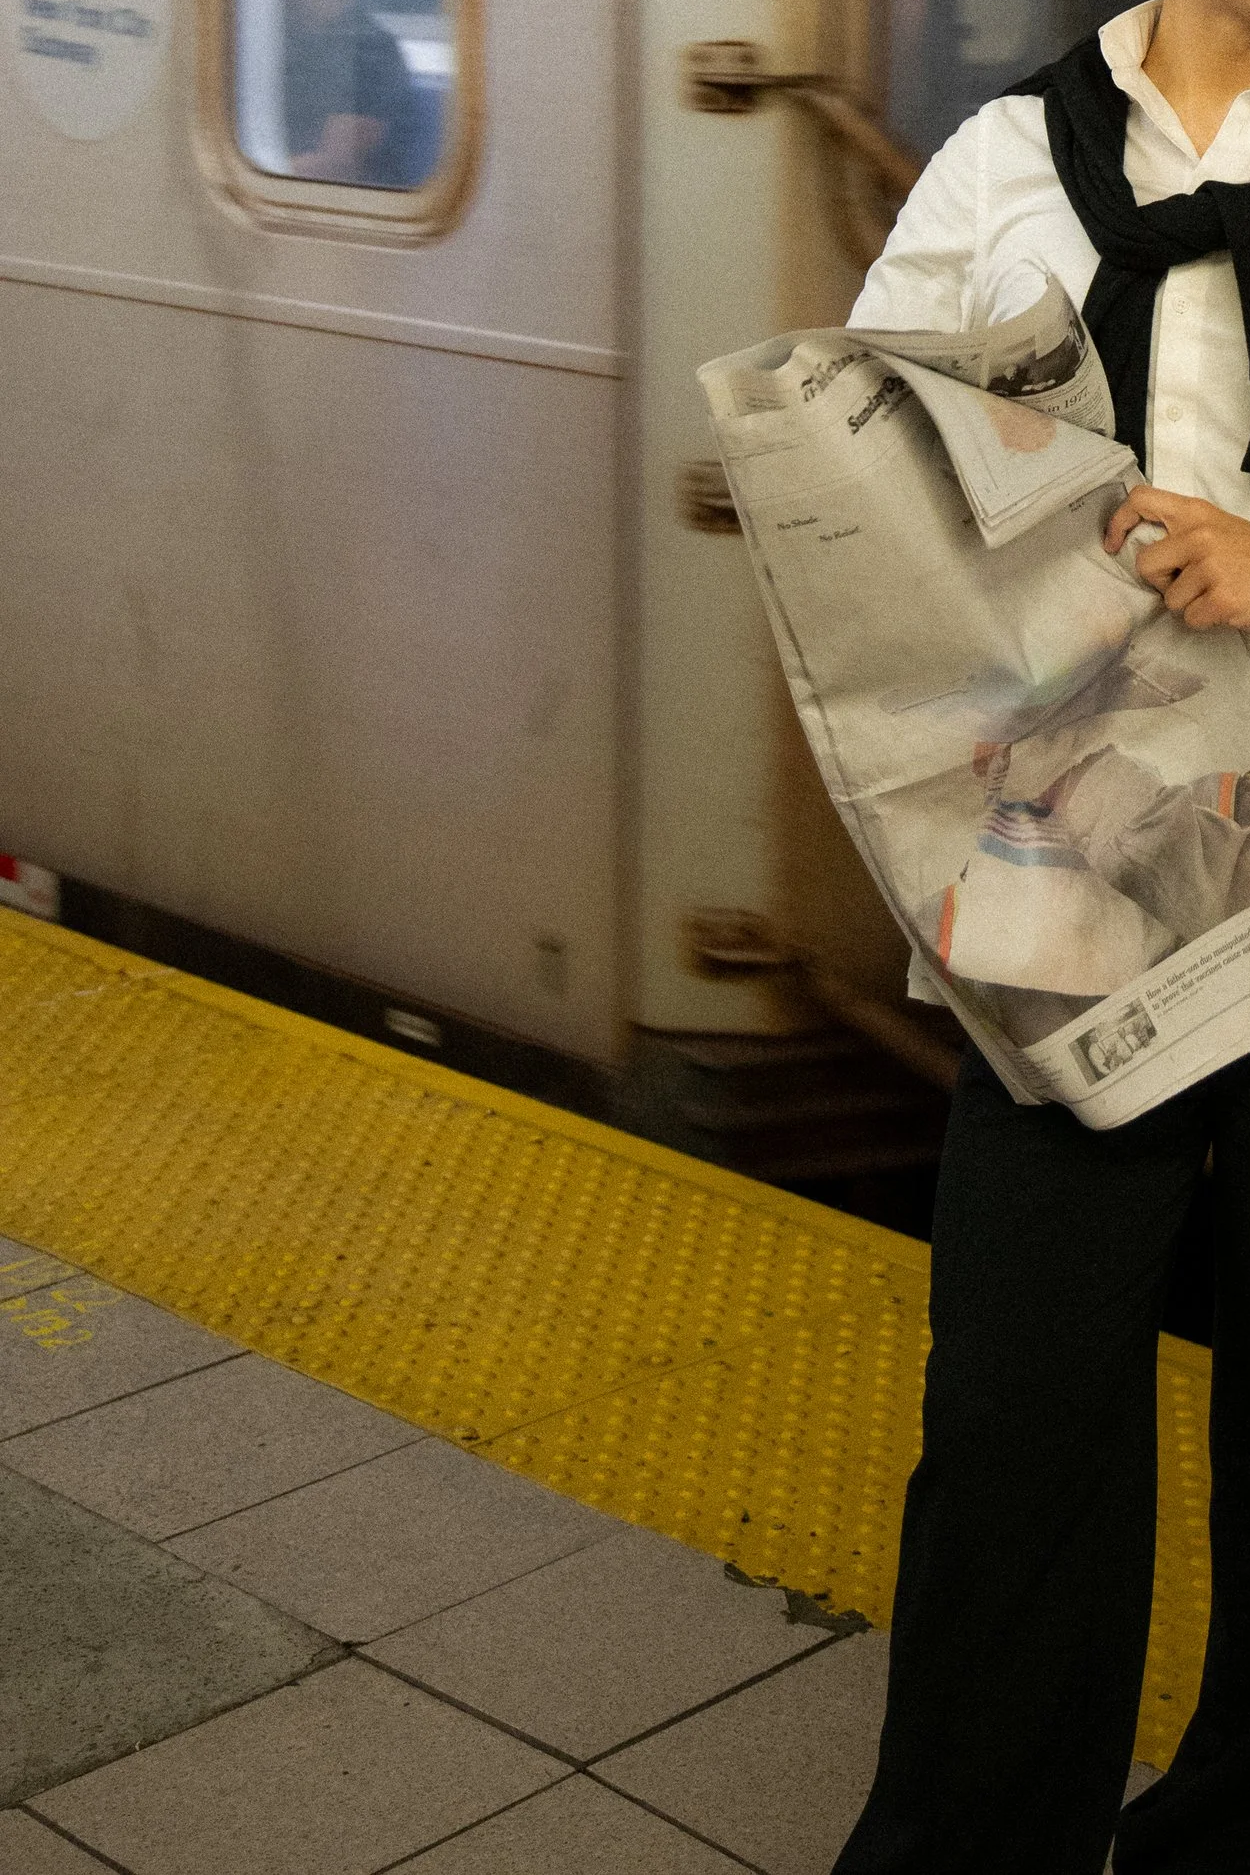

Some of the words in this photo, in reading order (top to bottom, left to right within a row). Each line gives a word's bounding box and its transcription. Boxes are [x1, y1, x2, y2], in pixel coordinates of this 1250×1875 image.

[1145, 988, 1161, 1000] How
[1199, 953, 1213, 966] duo
[1180, 978, 1195, 993] that
